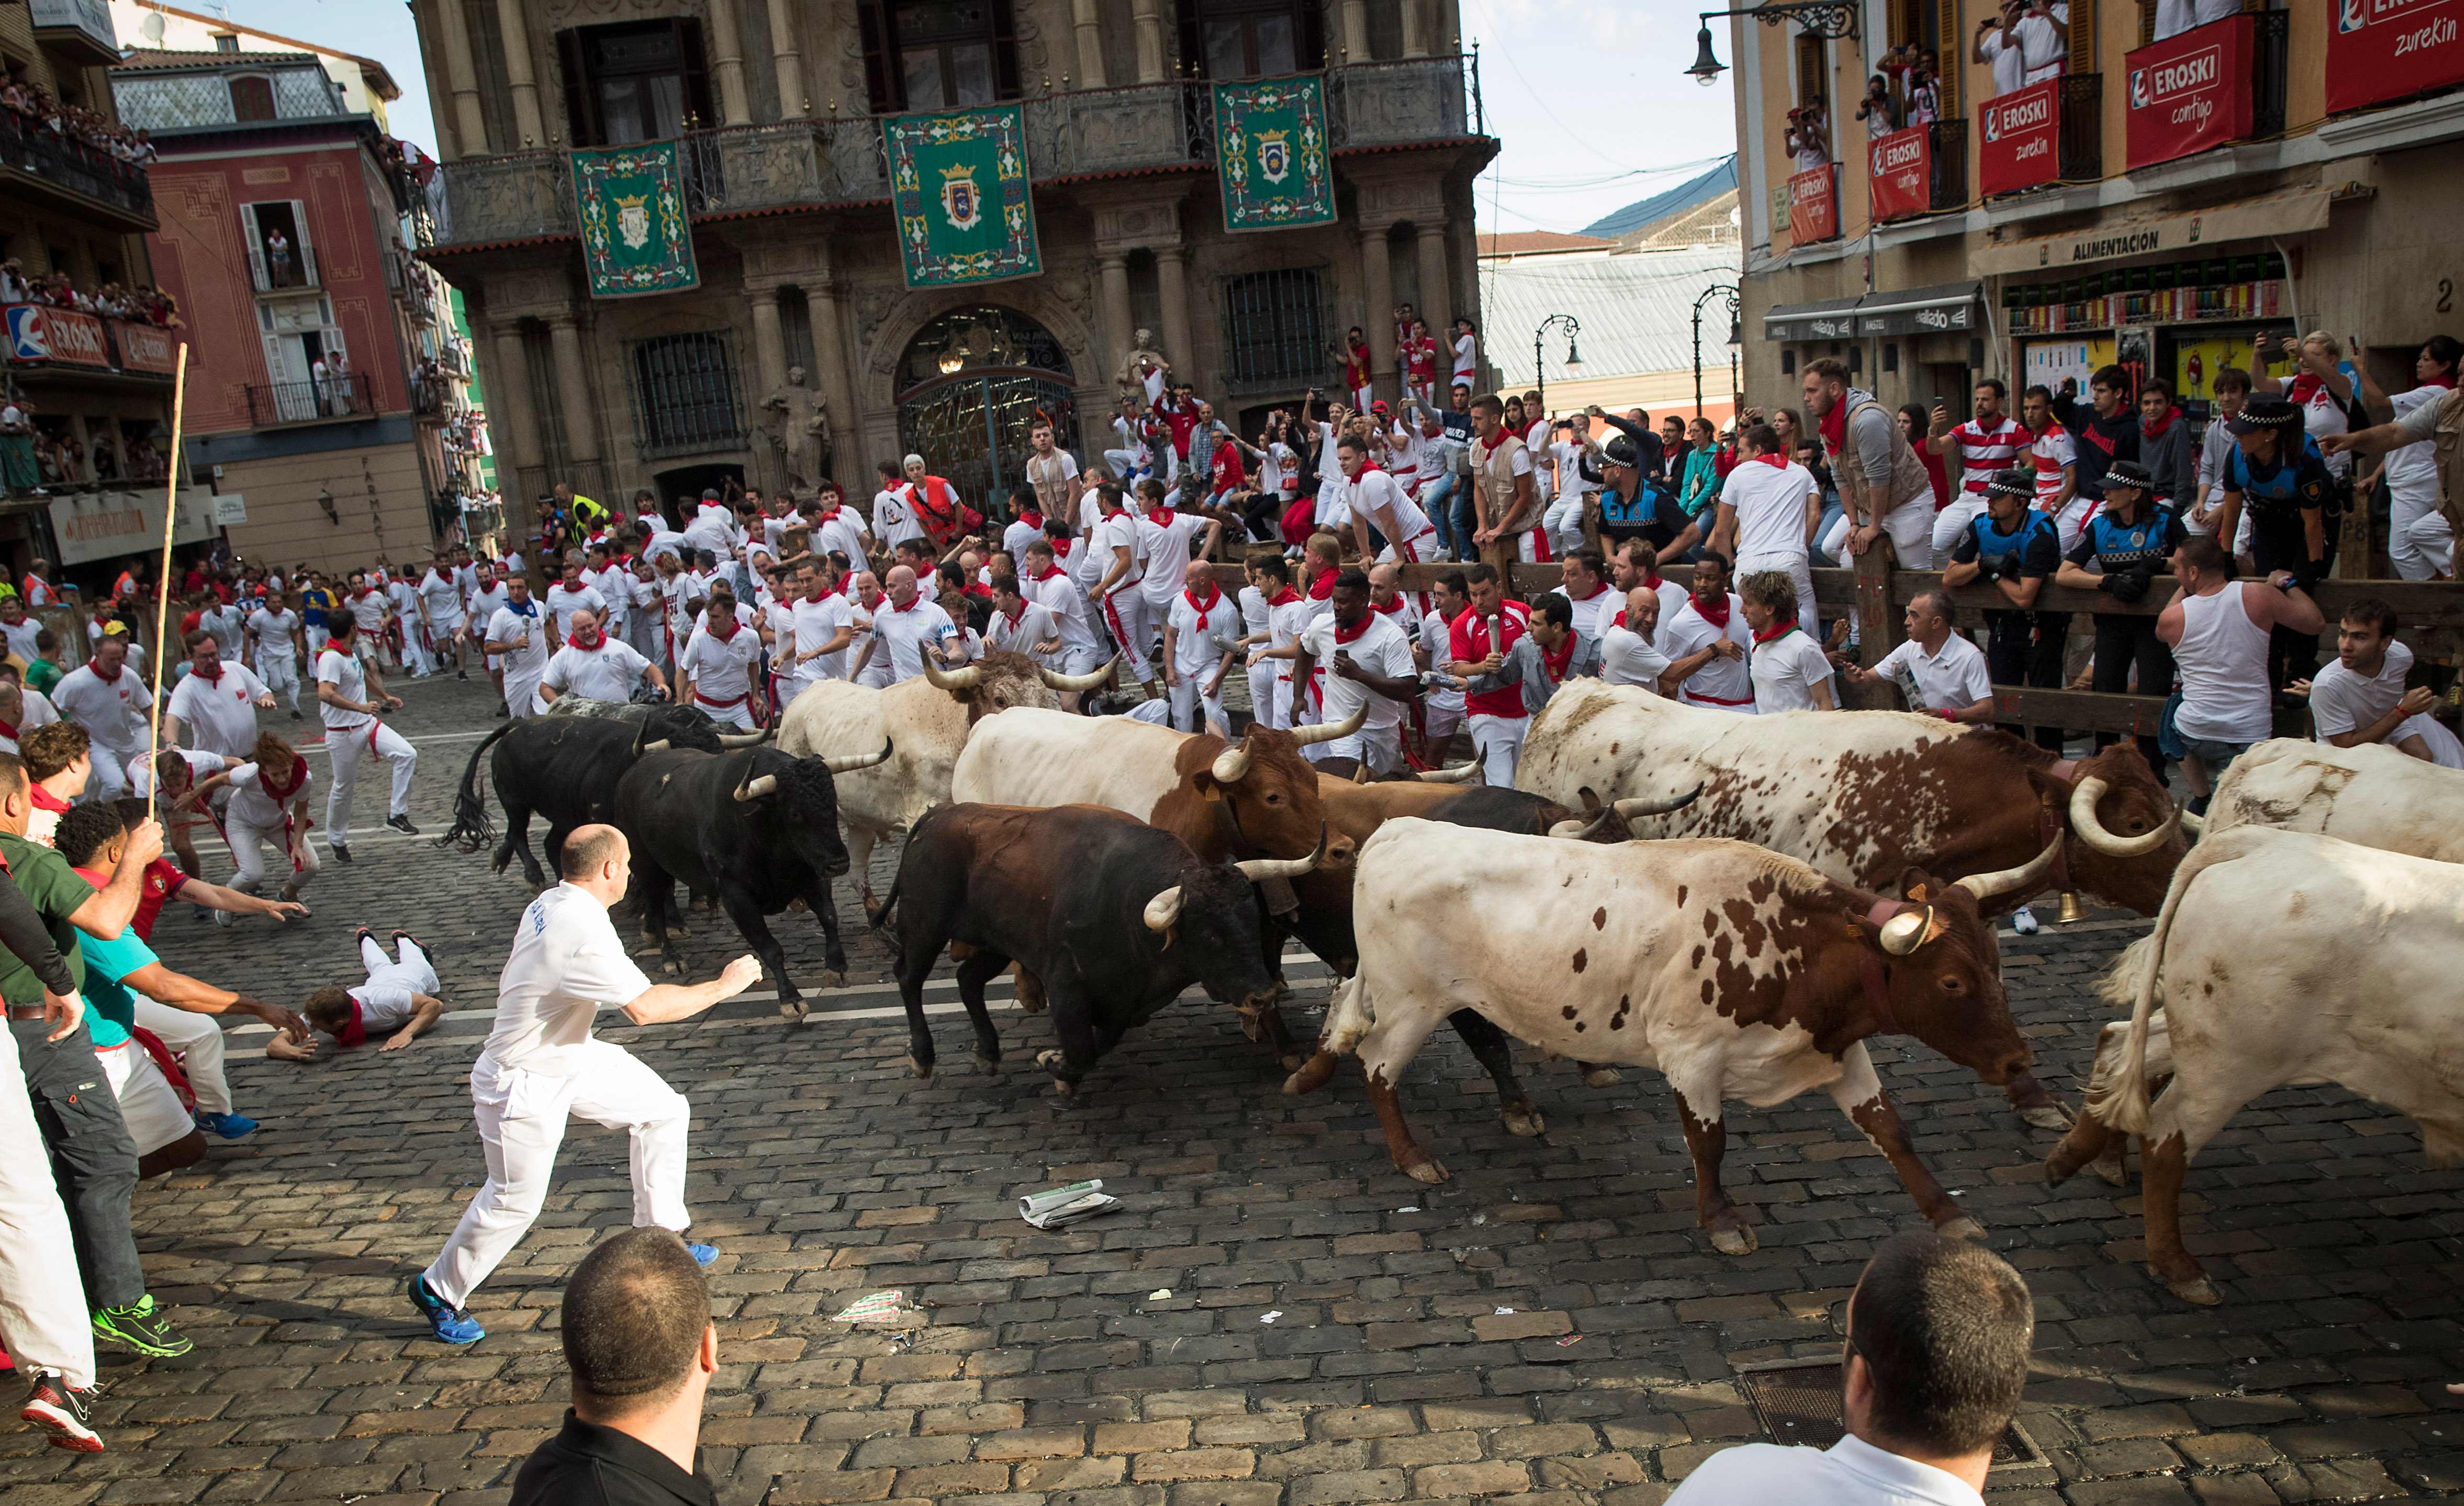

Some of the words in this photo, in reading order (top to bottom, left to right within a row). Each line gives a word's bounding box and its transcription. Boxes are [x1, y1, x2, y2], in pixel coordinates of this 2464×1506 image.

[2394, 16, 2457, 57] zurekin
[2154, 54, 2215, 95] EROSKI
[2003, 98, 2047, 130] EROSKI
[2172, 94, 2213, 133] contigo
[1887, 140, 1920, 167] EROSKI
[2016, 136, 2047, 161] zurekin
[1799, 177, 1826, 199] EROSKI
[1897, 168, 1920, 197] contigo
[2073, 227, 2159, 261] ALIMENTACIÓN
[2436, 278, 2453, 313] 2
[50, 319, 102, 352] EROSKI
[33, 1385, 63, 1407] NIKE
